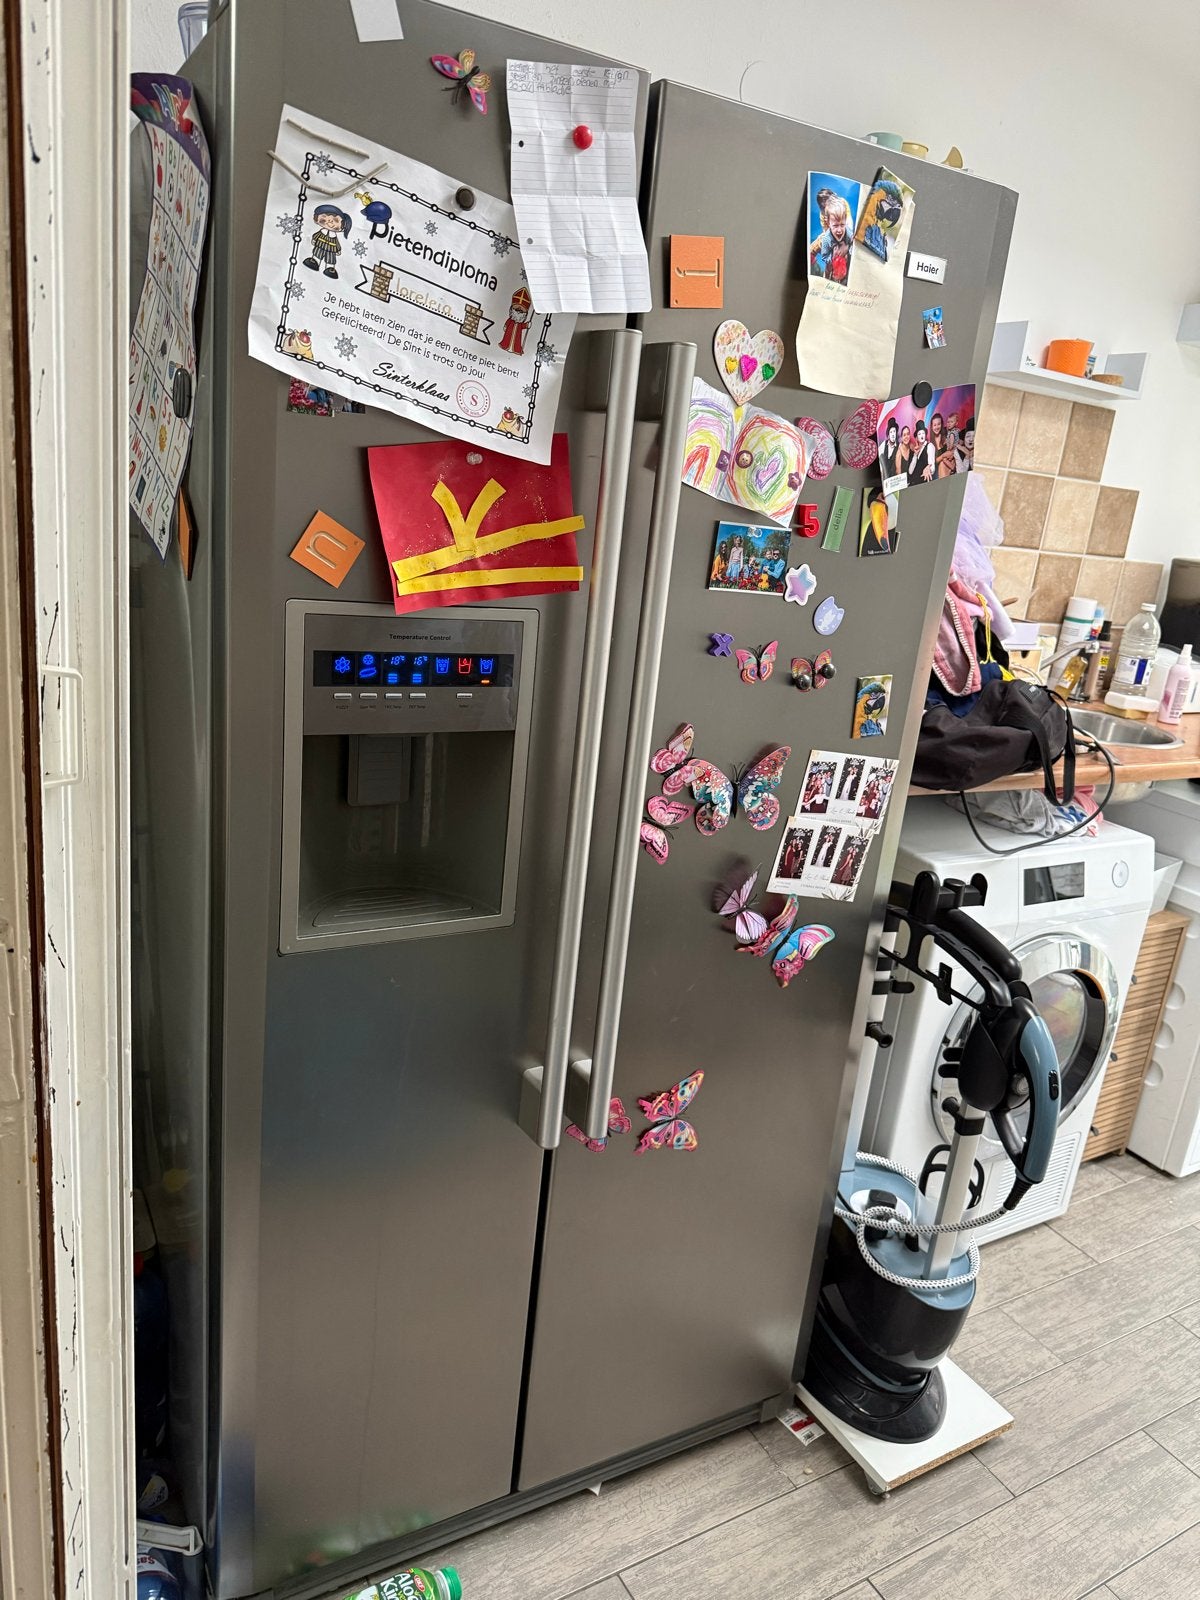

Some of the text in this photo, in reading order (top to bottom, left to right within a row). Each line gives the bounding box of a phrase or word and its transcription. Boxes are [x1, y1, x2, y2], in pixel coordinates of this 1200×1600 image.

[369, 221, 498, 292] Pietendiploma
[916, 261, 940, 275] Haier
[321, 307, 486, 380] Gefeliciteerd! De Sint is trots op jou!
[323, 291, 520, 379] Je hebt laten zien dat je een echte piet bent!
[372, 362, 450, 402] Sinterklaas
[470, 394, 479, 407] S
[802, 503, 820, 538] 5
